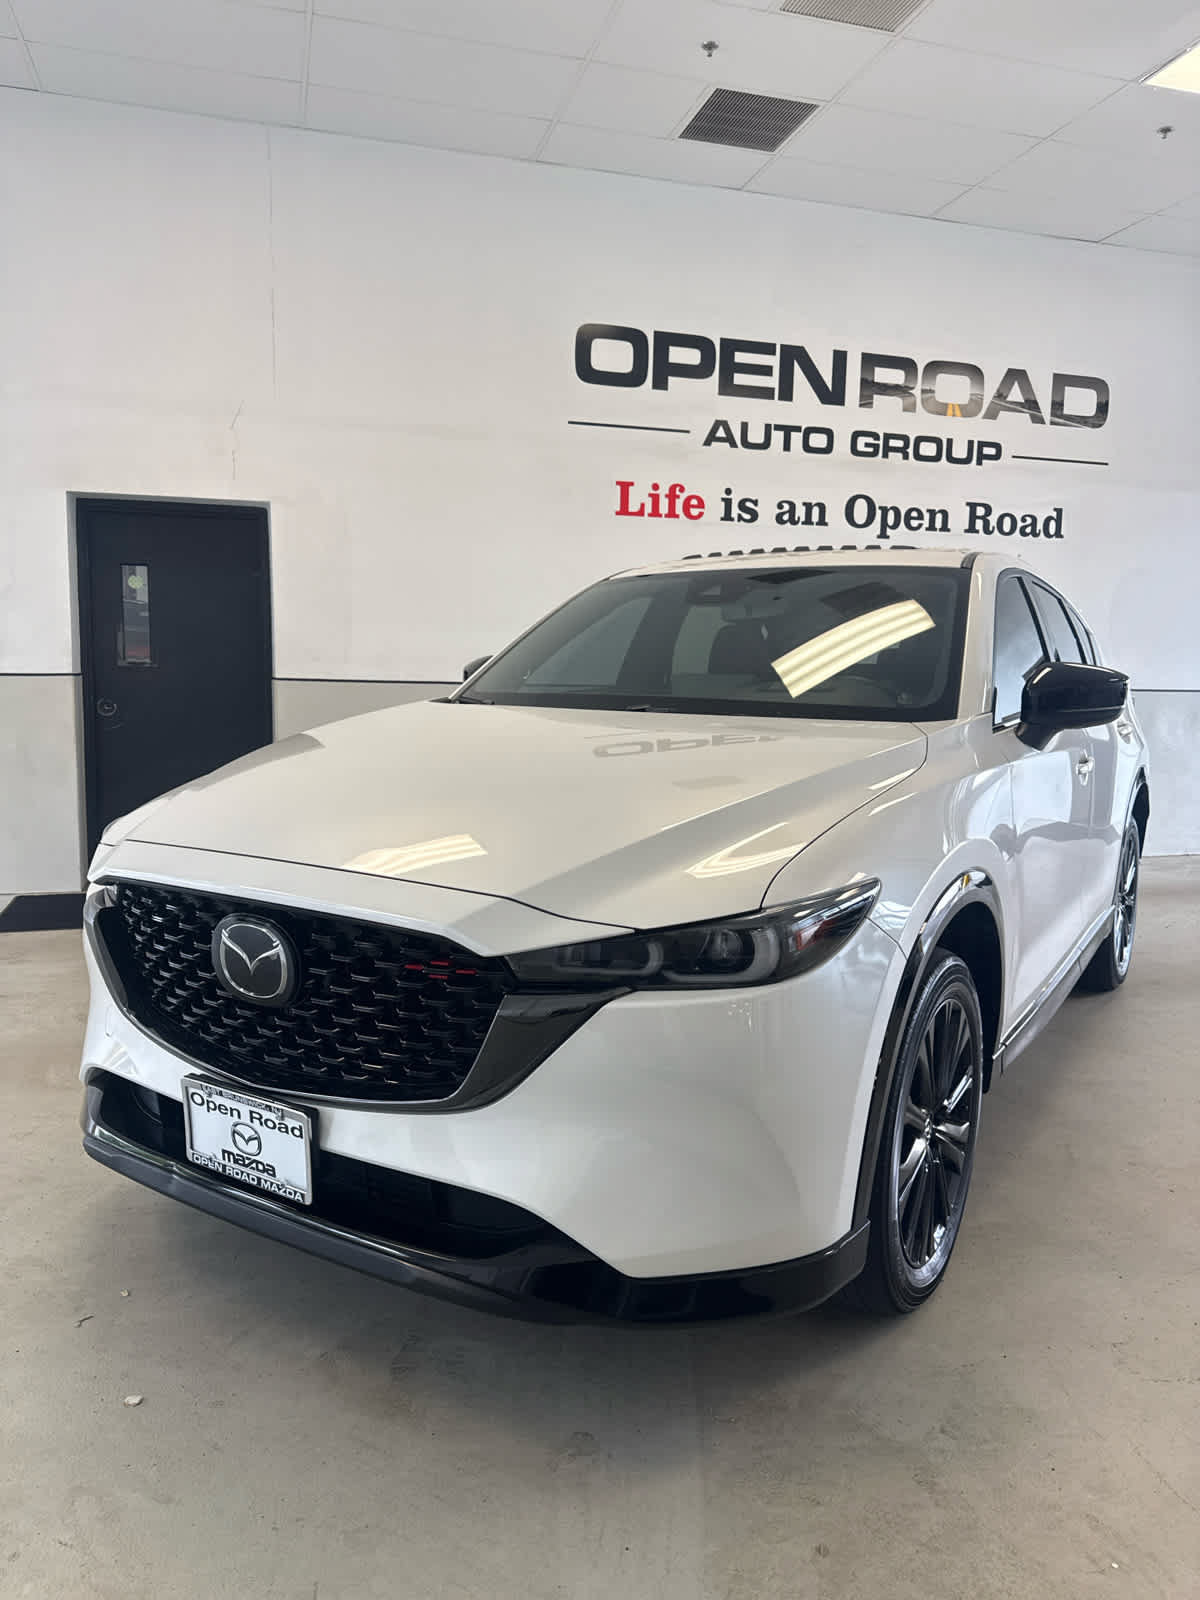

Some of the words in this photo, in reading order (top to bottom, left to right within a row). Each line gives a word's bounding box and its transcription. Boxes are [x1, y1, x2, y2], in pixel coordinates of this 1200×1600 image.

[574, 323, 848, 407] OPEN
[858, 351, 1111, 429] ROAD
[702, 419, 835, 455] AUTO
[850, 430, 1003, 467] GROUP
[614, 481, 706, 520] Life
[719, 487, 760, 523] is
[775, 499, 829, 527] an
[844, 494, 951, 538] Open
[963, 501, 1065, 539] Road
[190, 1092, 242, 1120] Open
[249, 1109, 304, 1139] Road
[192, 1154, 223, 1173] OPEN
[225, 1166, 258, 1186] ROAD
[260, 1179, 304, 1203] MAZDA
[222, 1149, 277, 1178] mazda
